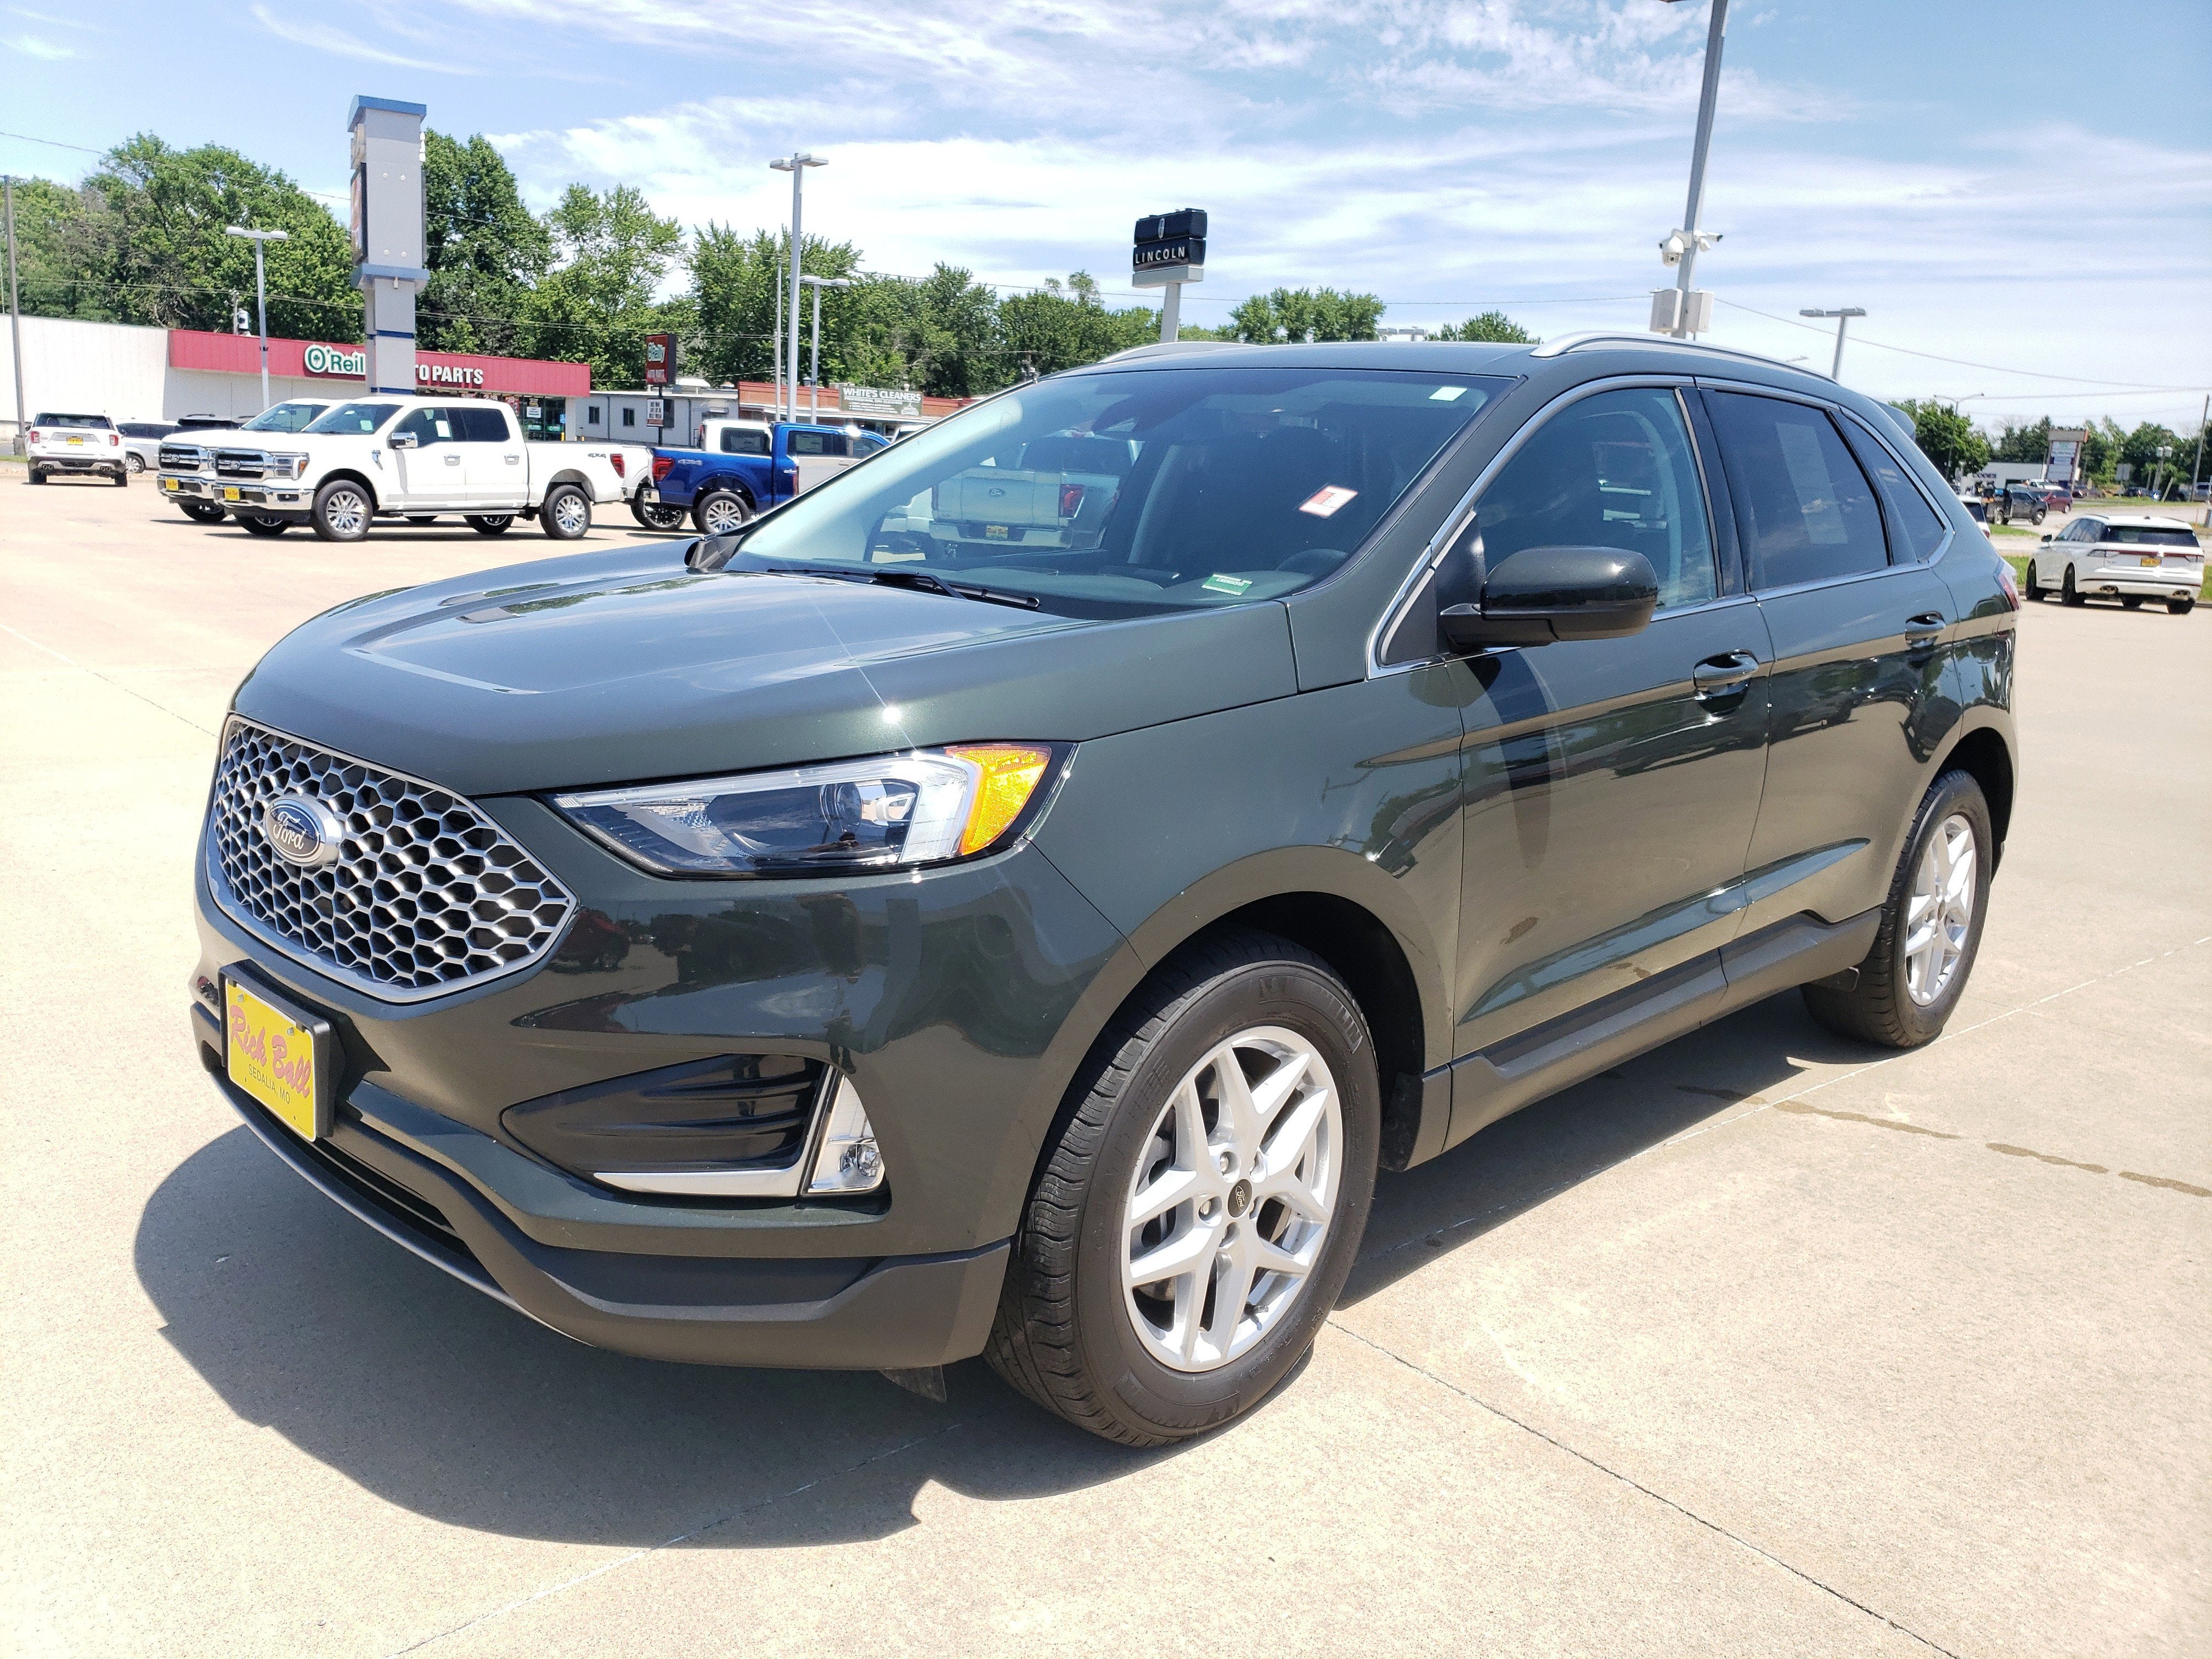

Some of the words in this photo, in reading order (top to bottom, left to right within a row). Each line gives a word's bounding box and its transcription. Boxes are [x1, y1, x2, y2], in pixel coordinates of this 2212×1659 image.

[1135, 246, 1185, 263] LINCOLN
[305, 345, 365, 375] O'Reil
[432, 365, 483, 384] PARTS
[843, 387, 877, 398] WHITE'S
[879, 391, 921, 401] CLEANERS
[274, 811, 306, 850] Ford
[230, 1005, 267, 1067] Rich
[272, 1034, 311, 1098] Ball
[249, 1064, 278, 1098] SEDALIA,
[280, 1087, 290, 1104] MO
